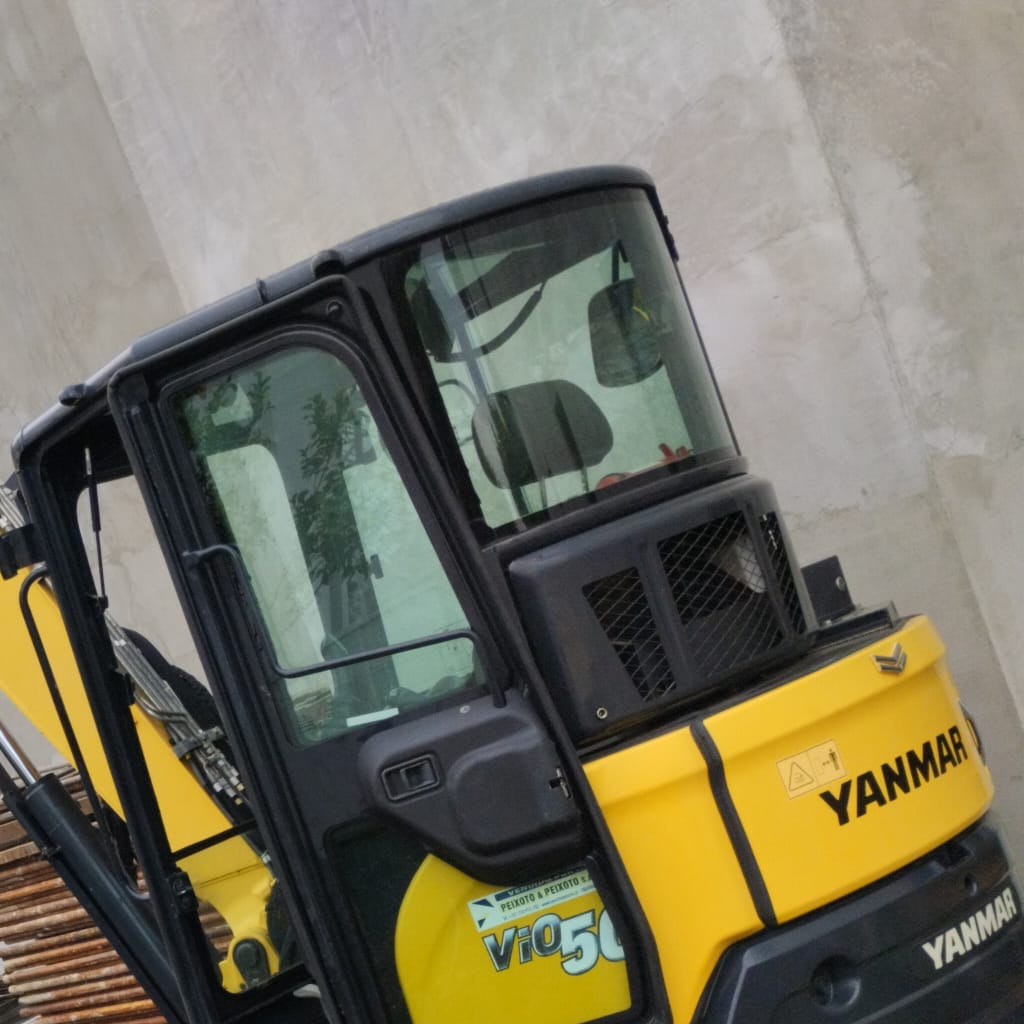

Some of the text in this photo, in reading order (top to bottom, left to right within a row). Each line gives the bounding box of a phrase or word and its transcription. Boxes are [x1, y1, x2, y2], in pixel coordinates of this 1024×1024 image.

[819, 725, 968, 826] YANMAR
[500, 893, 535, 912] PEIXOTO
[544, 877, 580, 896] PEIXOTO
[922, 887, 1018, 971] YANMAR
